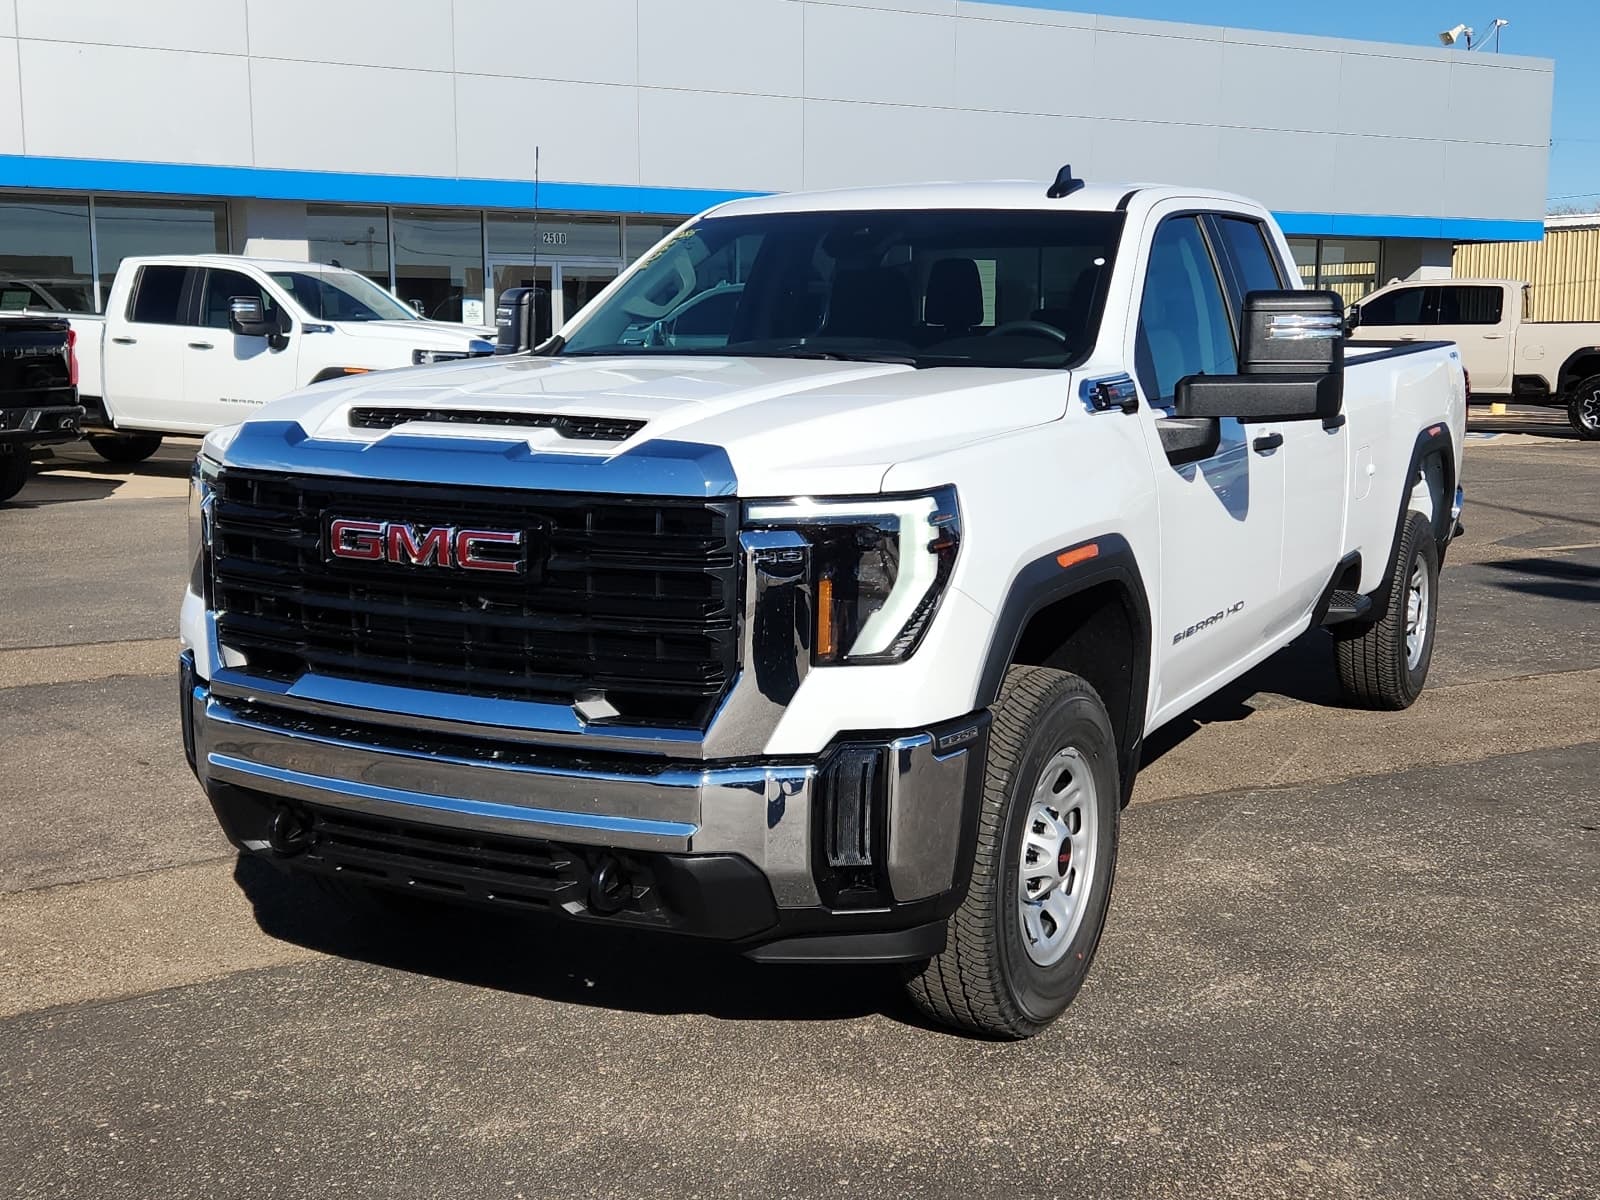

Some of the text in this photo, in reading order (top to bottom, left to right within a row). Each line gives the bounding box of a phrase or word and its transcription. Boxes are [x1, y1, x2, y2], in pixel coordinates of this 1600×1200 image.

[543, 232, 566, 244] 2500
[330, 519, 523, 573] GMC
[1172, 600, 1245, 646] SIERRA HD
